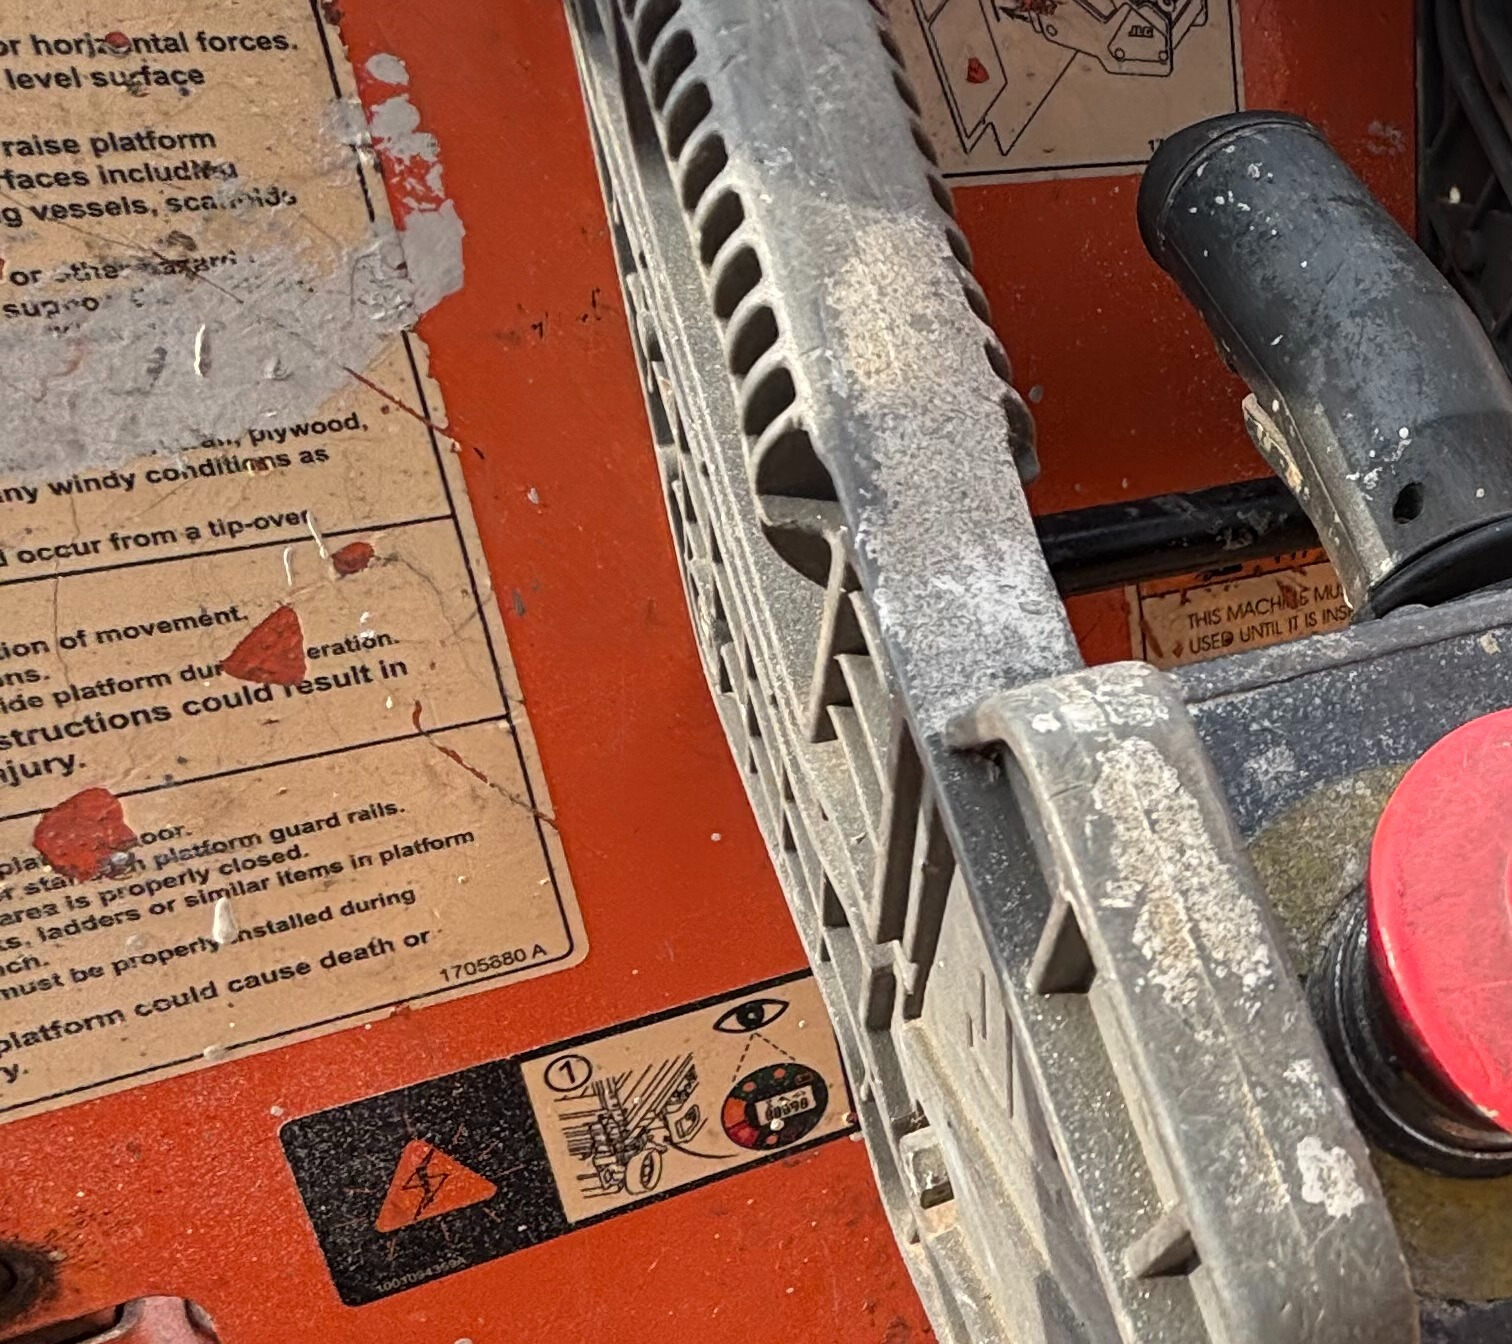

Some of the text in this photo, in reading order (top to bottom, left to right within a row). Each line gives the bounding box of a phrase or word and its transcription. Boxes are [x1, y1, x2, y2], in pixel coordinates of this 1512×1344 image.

[29, 31, 189, 57] horizntal
[195, 30, 299, 52] forces.
[4, 66, 83, 90] level
[1, 130, 216, 158] raise platform
[29, 196, 158, 221] vessels,
[9, 268, 42, 286] or
[48, 471, 136, 497] windy
[298, 445, 331, 465] as
[17, 538, 102, 564] occur
[109, 528, 178, 552] from
[185, 525, 201, 542] a
[60, 628, 88, 650] of
[95, 605, 250, 645] movement.
[1188, 608, 1222, 629] THIS
[1189, 630, 1234, 654] USED
[1239, 620, 1284, 643] UNTIL
[1288, 614, 1299, 633] IT
[1304, 611, 1319, 628] IS
[52, 671, 173, 709] platform
[307, 630, 401, 660] eration.
[182, 681, 274, 717] could
[284, 663, 374, 699] result
[381, 659, 408, 680] in
[153, 833, 262, 871] platform
[269, 811, 340, 845] guard
[347, 801, 406, 825] rails.
[0, 902, 60, 927] area
[65, 894, 92, 911] is
[98, 866, 210, 907] properly
[218, 843, 310, 876] closed.
[37, 906, 141, 943] ladders
[149, 898, 176, 916] or
[184, 876, 271, 908] similar
[275, 858, 344, 887] items
[350, 852, 373, 871] in
[379, 829, 475, 867] platform
[70, 963, 105, 984] be
[111, 936, 221, 977] properly
[231, 905, 334, 944] nstalled
[340, 887, 417, 918] during
[531, 942, 548, 960] A
[134, 980, 219, 1018] could
[228, 960, 312, 995] cause
[319, 936, 395, 970] death
[403, 928, 431, 948] or
